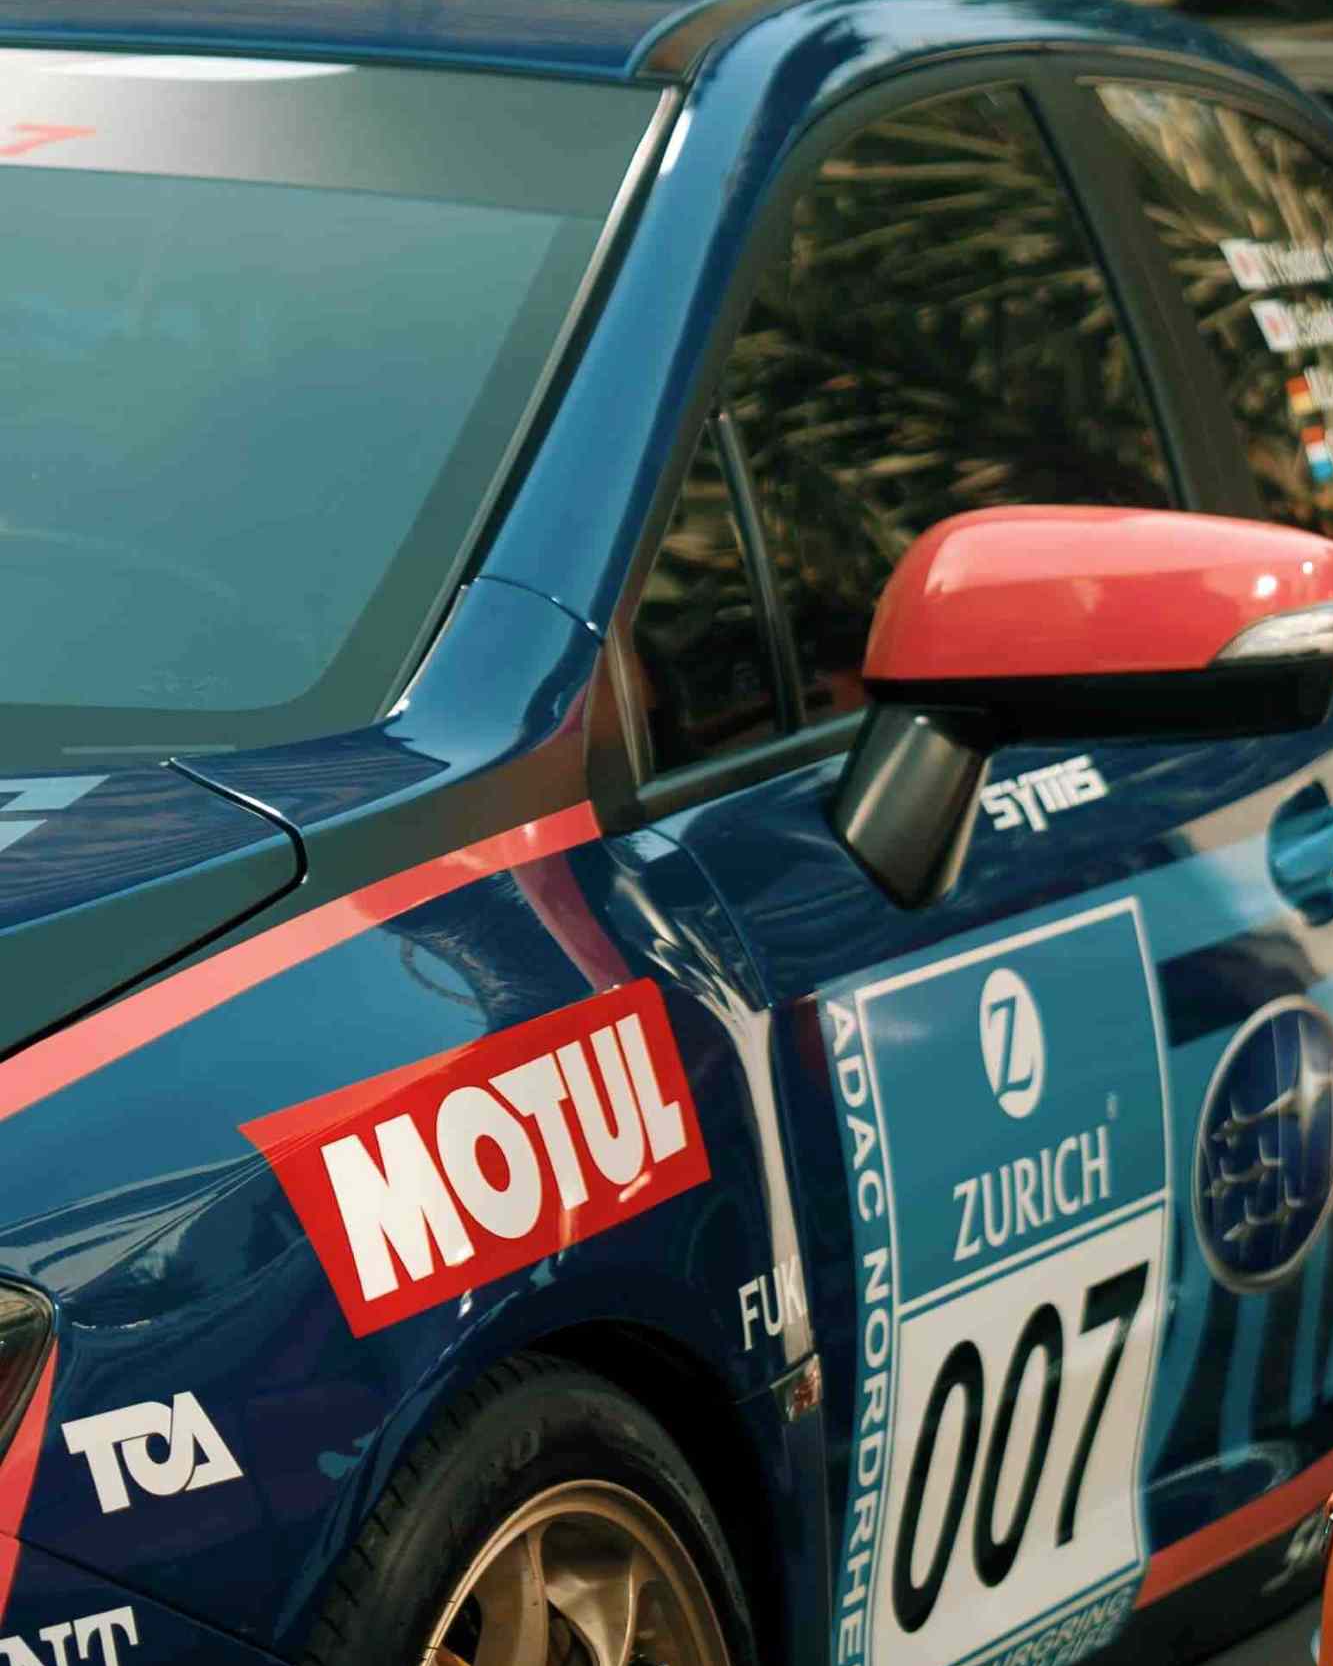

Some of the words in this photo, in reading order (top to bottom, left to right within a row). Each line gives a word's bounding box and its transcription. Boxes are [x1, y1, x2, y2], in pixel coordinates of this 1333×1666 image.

[321, 1013, 687, 1302] MOTUL
[826, 1000, 885, 1223] ADAC
[953, 1125, 1110, 1262] ZURICH
[61, 1391, 244, 1514] TOA
[892, 1260, 1150, 1634] 007
